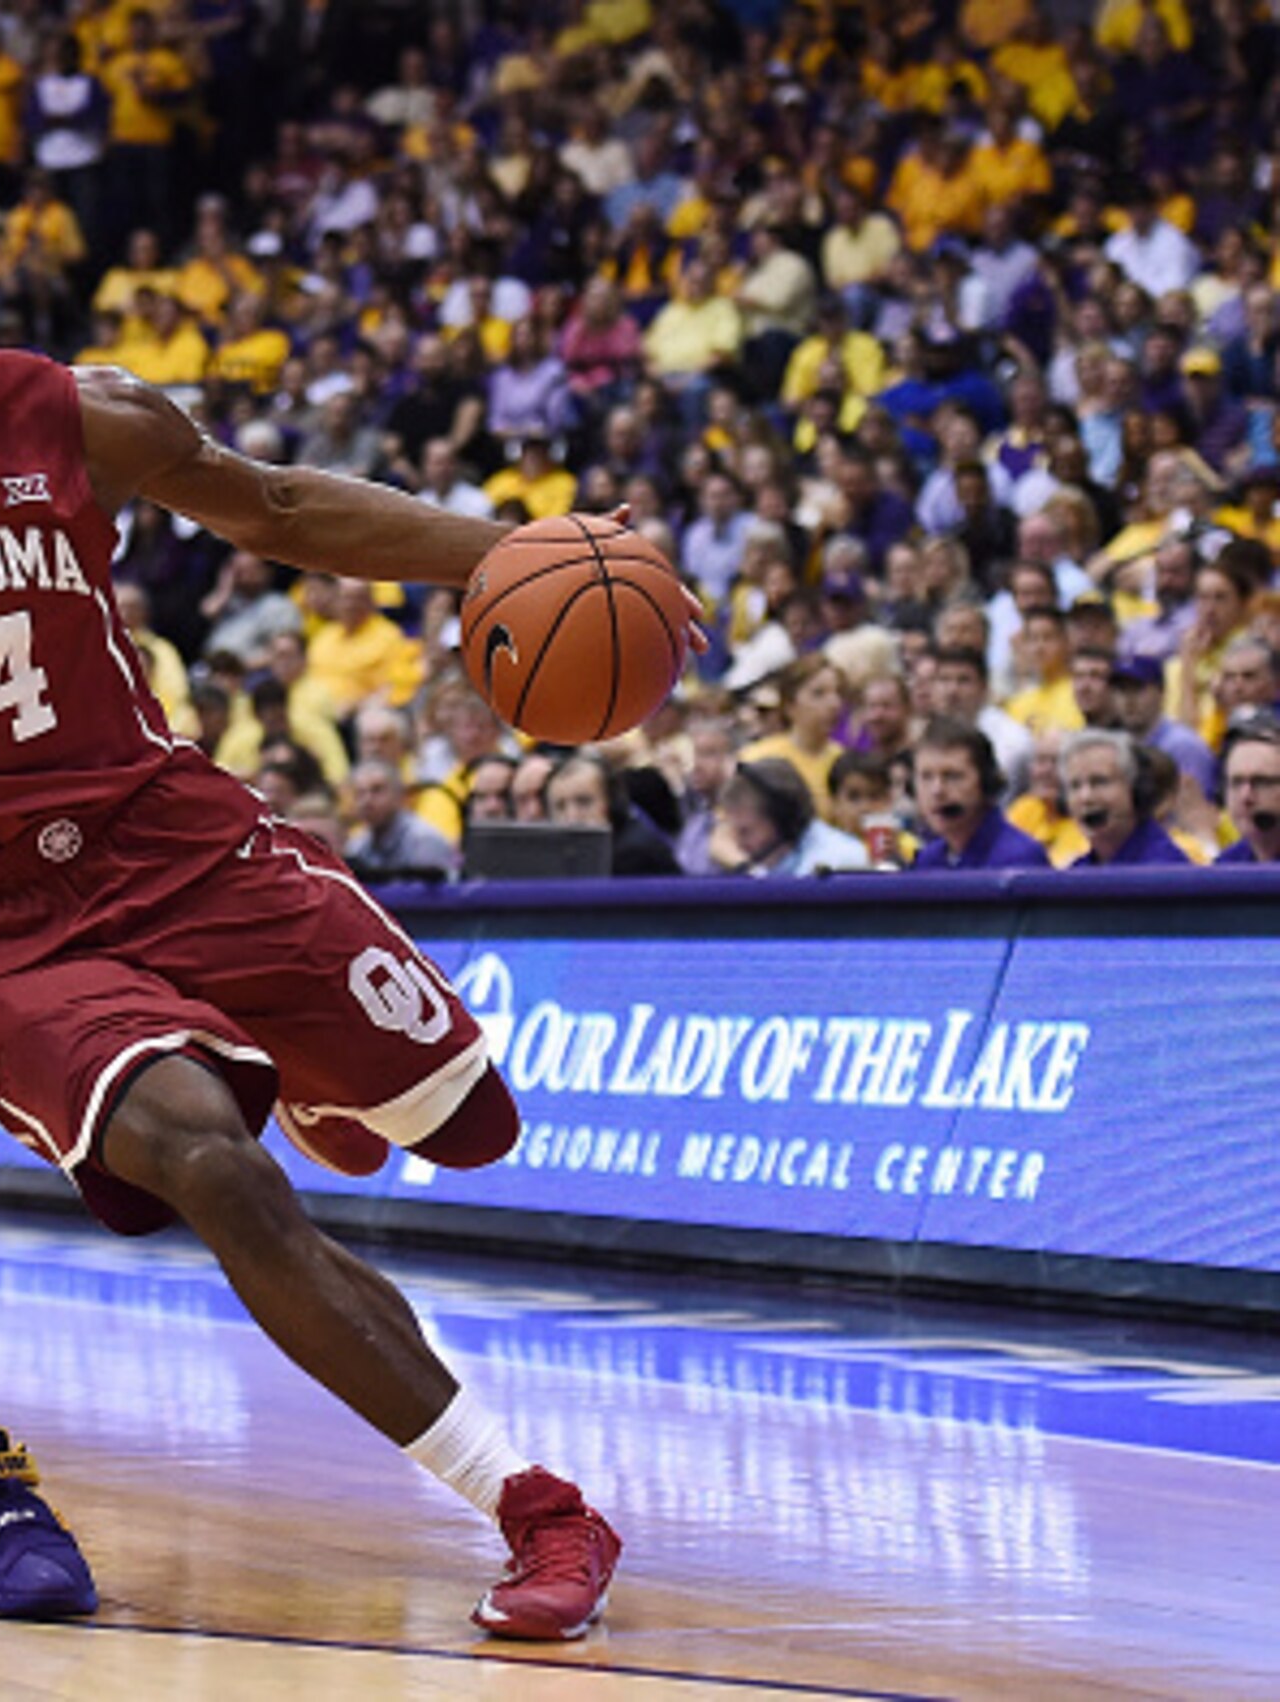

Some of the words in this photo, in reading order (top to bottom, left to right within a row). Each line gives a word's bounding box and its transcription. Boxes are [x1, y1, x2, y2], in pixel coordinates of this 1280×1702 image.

[509, 1000, 616, 1093] OUR
[607, 1003, 753, 1098] LADY
[740, 1016, 819, 1102] OF
[814, 1017, 931, 1106] THE
[921, 1009, 1090, 1111] LAKE
[677, 1132, 854, 1190] MEDICAL
[874, 1143, 1045, 1201] CENTER
